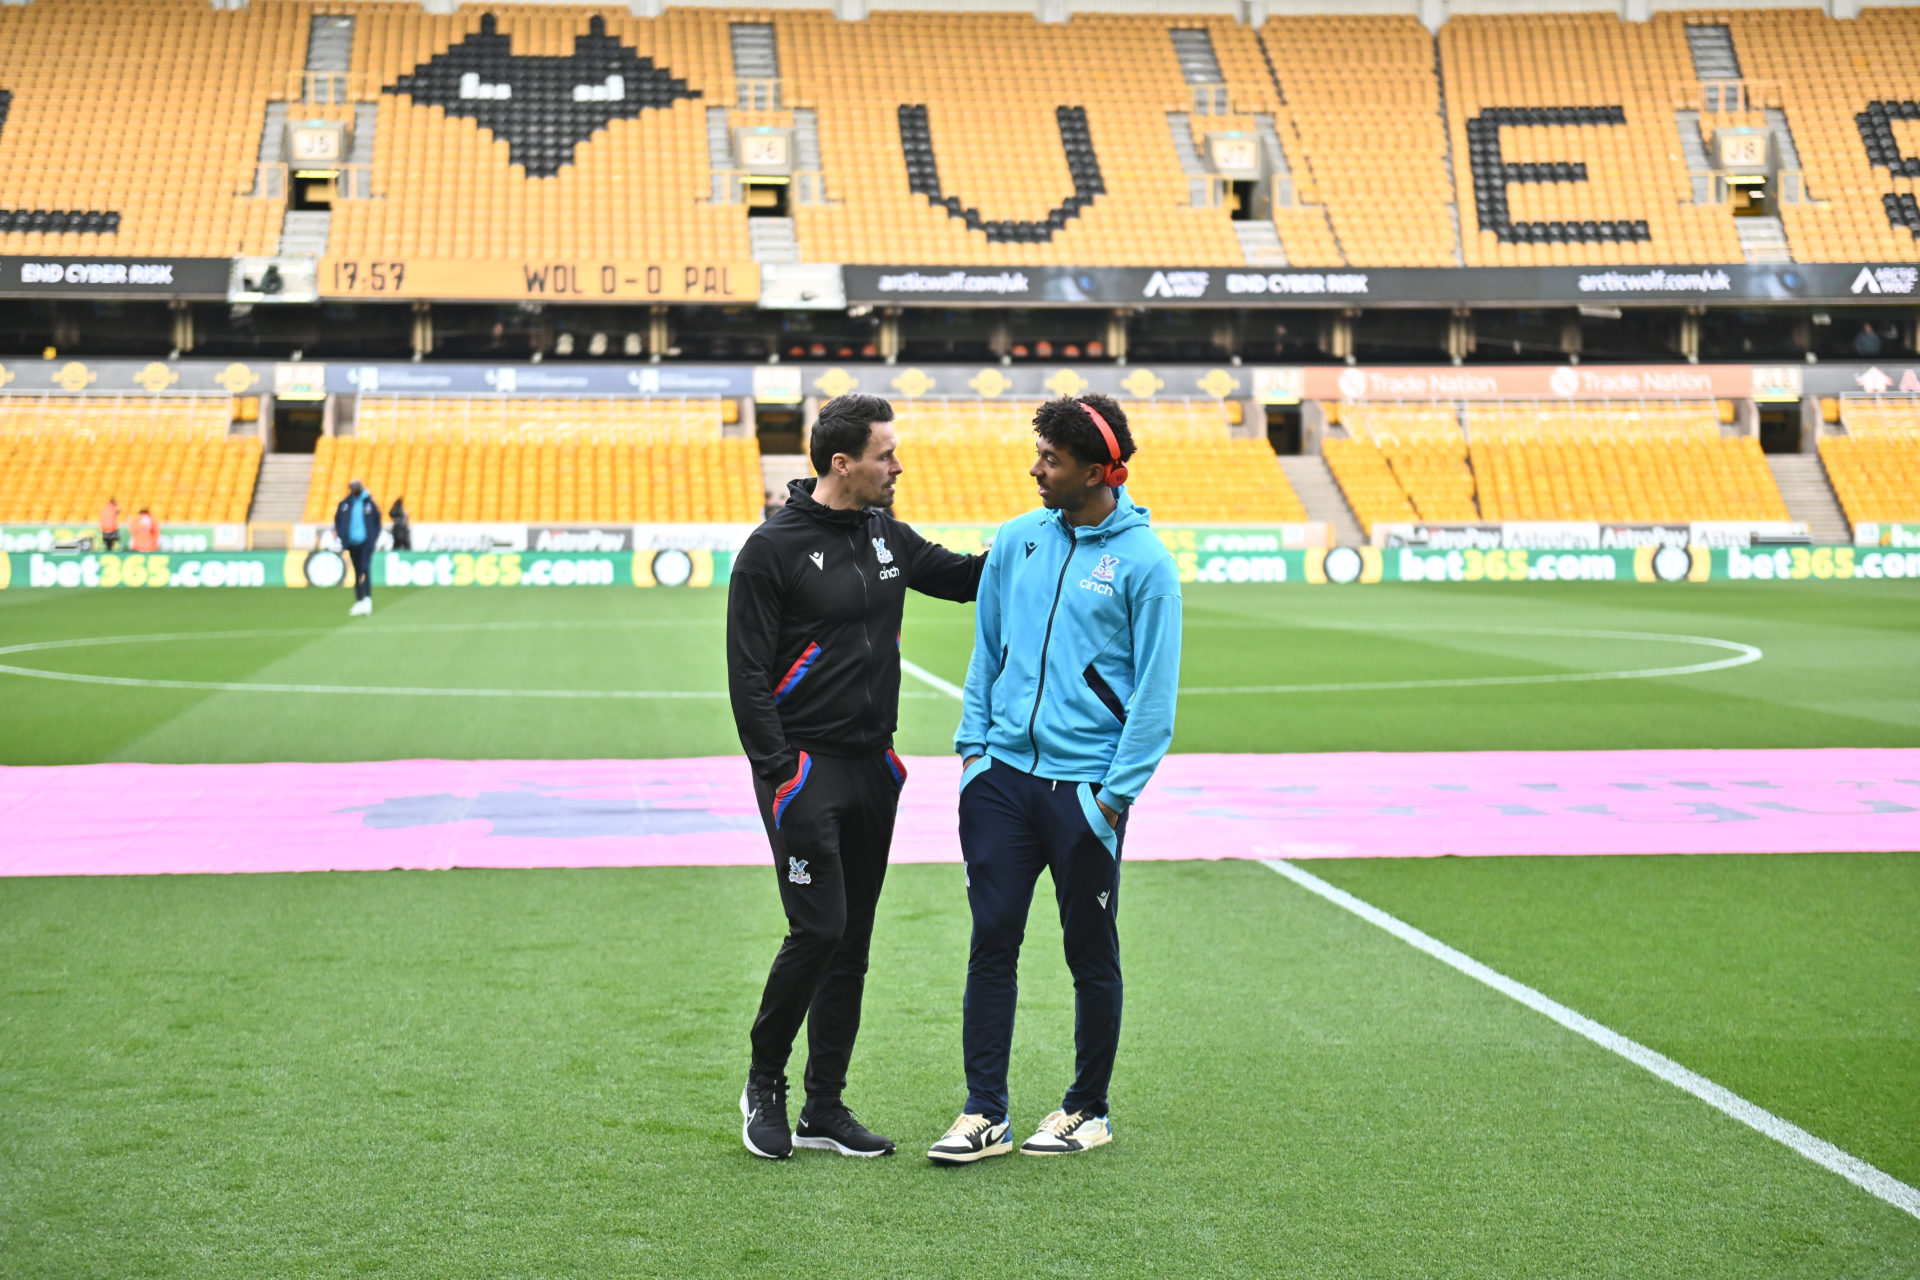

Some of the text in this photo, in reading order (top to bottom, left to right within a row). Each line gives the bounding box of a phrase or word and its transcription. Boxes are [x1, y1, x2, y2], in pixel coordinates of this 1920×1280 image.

[21, 263, 174, 284] END CYBER RISK
[335, 262, 404, 290] 17:57
[524, 264, 583, 293] WOL
[685, 266, 734, 295] PAL
[1226, 274, 1268, 293] END
[1326, 274, 1368, 293] RISK
[1578, 270, 1731, 293] arcticwolf.com/uk
[1369, 373, 1497, 394] Trade Nation
[1582, 371, 1712, 393] Trade Nation
[537, 530, 625, 551] AstroPay
[1602, 527, 1688, 548] AstroPay
[30, 553, 265, 587] bet365.com
[385, 552, 614, 586] bet365.com
[880, 565, 900, 580] cinch
[1399, 548, 1616, 581] bet365.com
[1080, 576, 1114, 597] cinch
